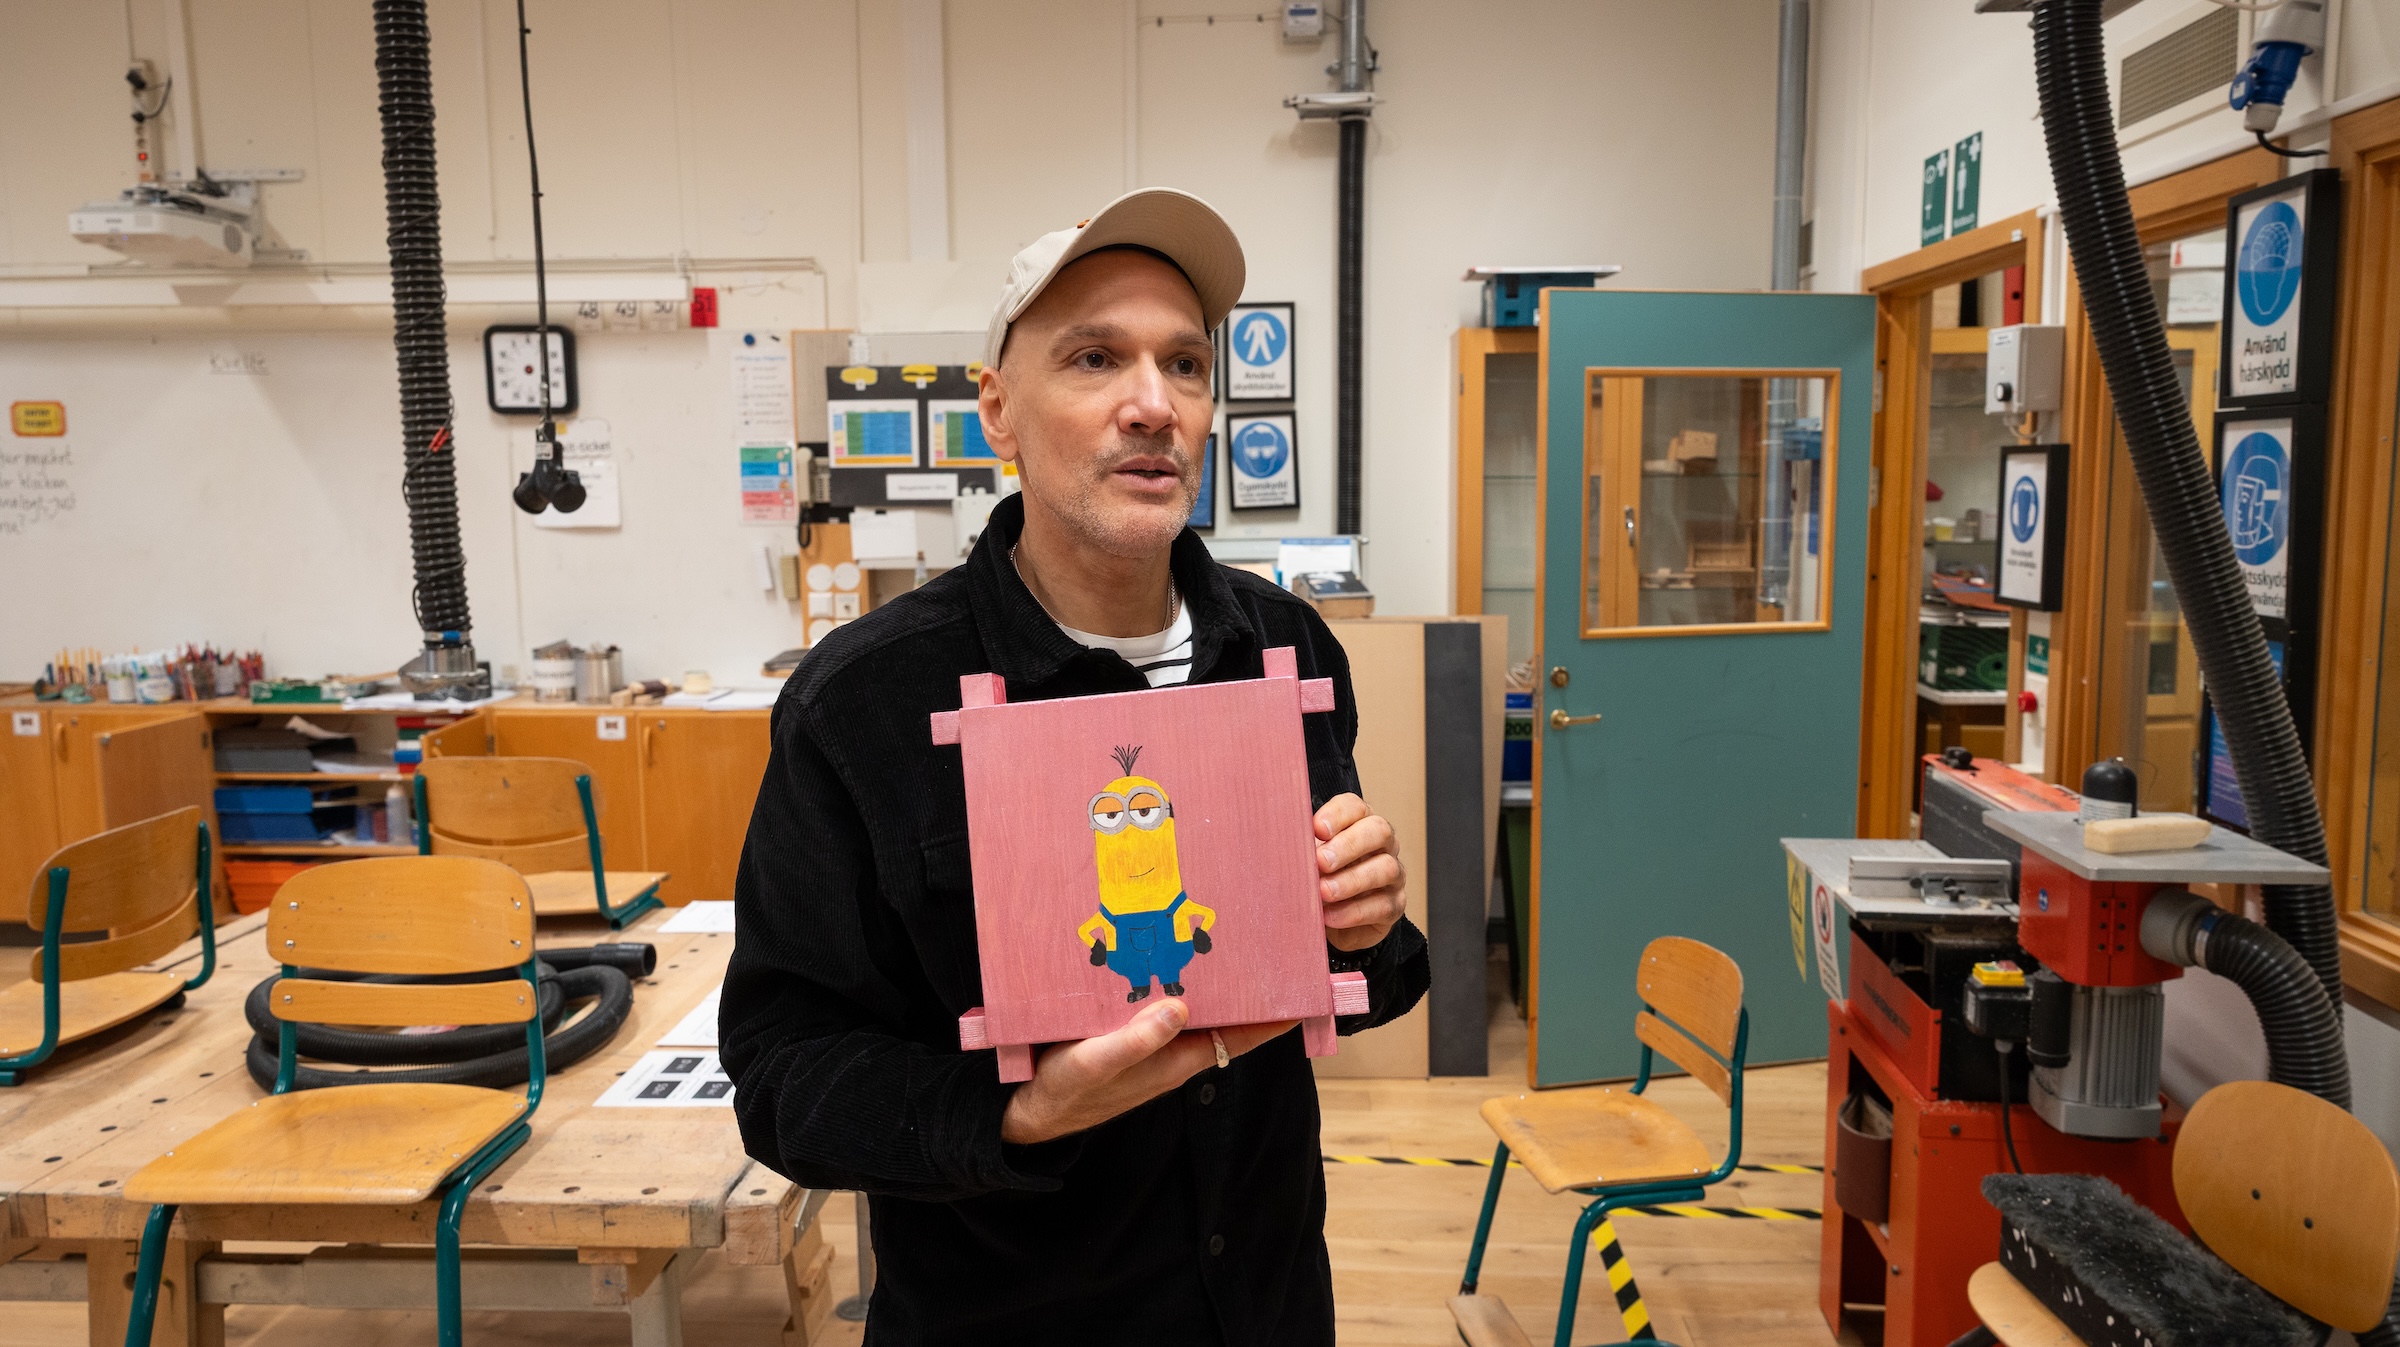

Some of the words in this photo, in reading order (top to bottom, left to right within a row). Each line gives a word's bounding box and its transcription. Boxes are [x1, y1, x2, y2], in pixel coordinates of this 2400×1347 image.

[694, 294, 713, 312] 51
[2244, 331, 2287, 356] Använd
[2240, 358, 2290, 384] hårskydd
